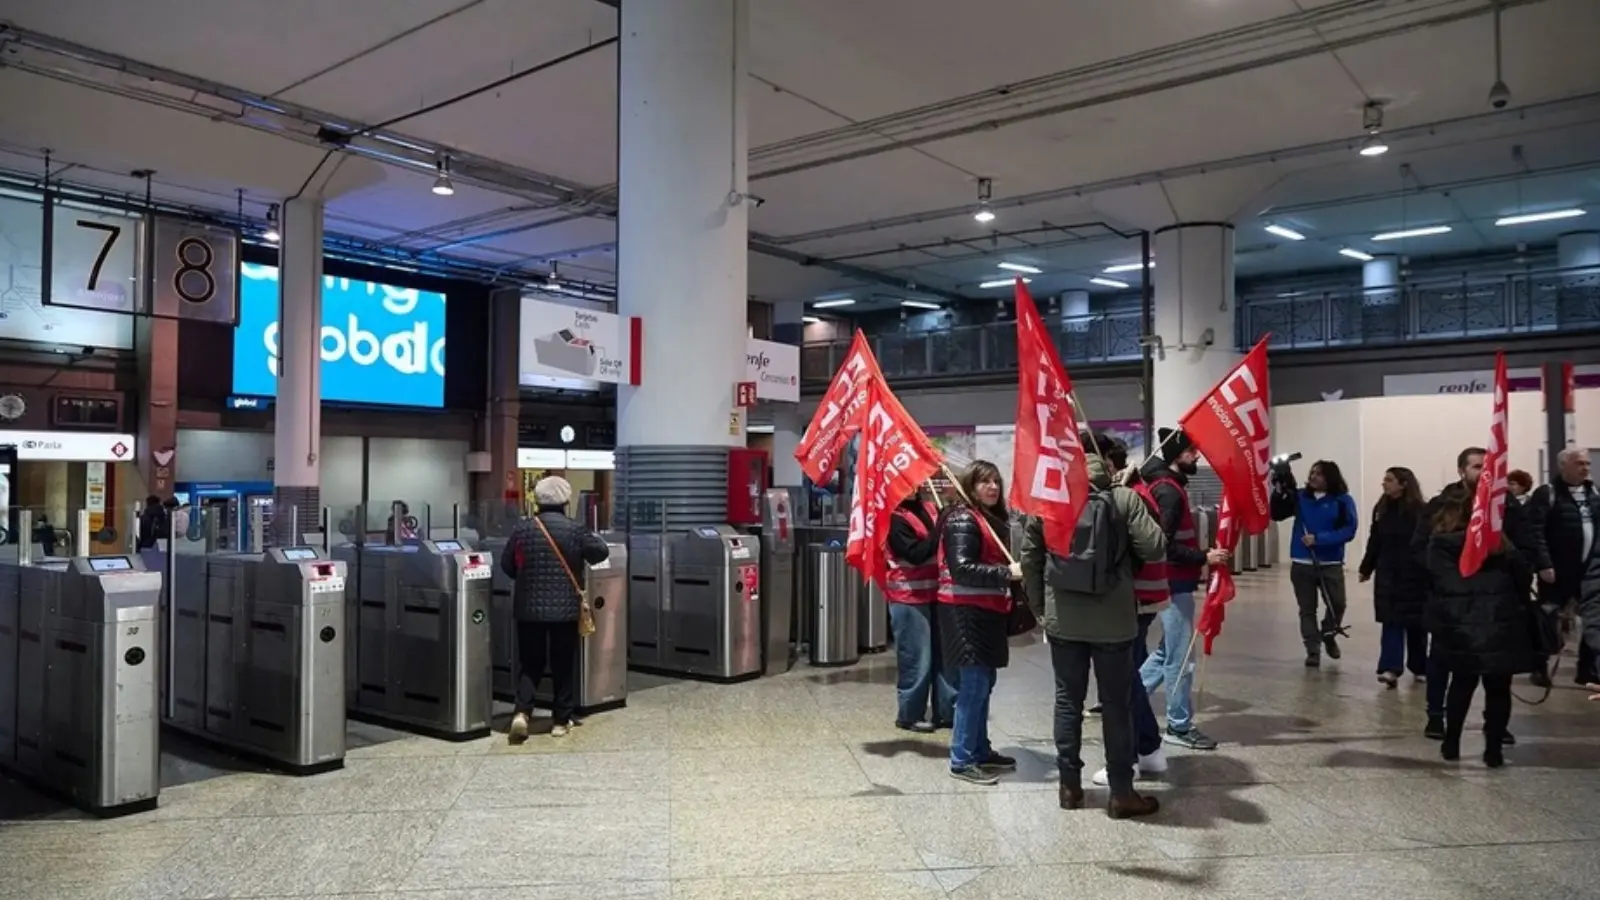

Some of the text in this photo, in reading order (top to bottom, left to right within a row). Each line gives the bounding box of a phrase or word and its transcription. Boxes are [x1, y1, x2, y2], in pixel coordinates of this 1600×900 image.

[76, 219, 121, 290] 7
[173, 237, 216, 303] 8
[746, 351, 770, 371] enfe
[1438, 379, 1487, 394] renfe
